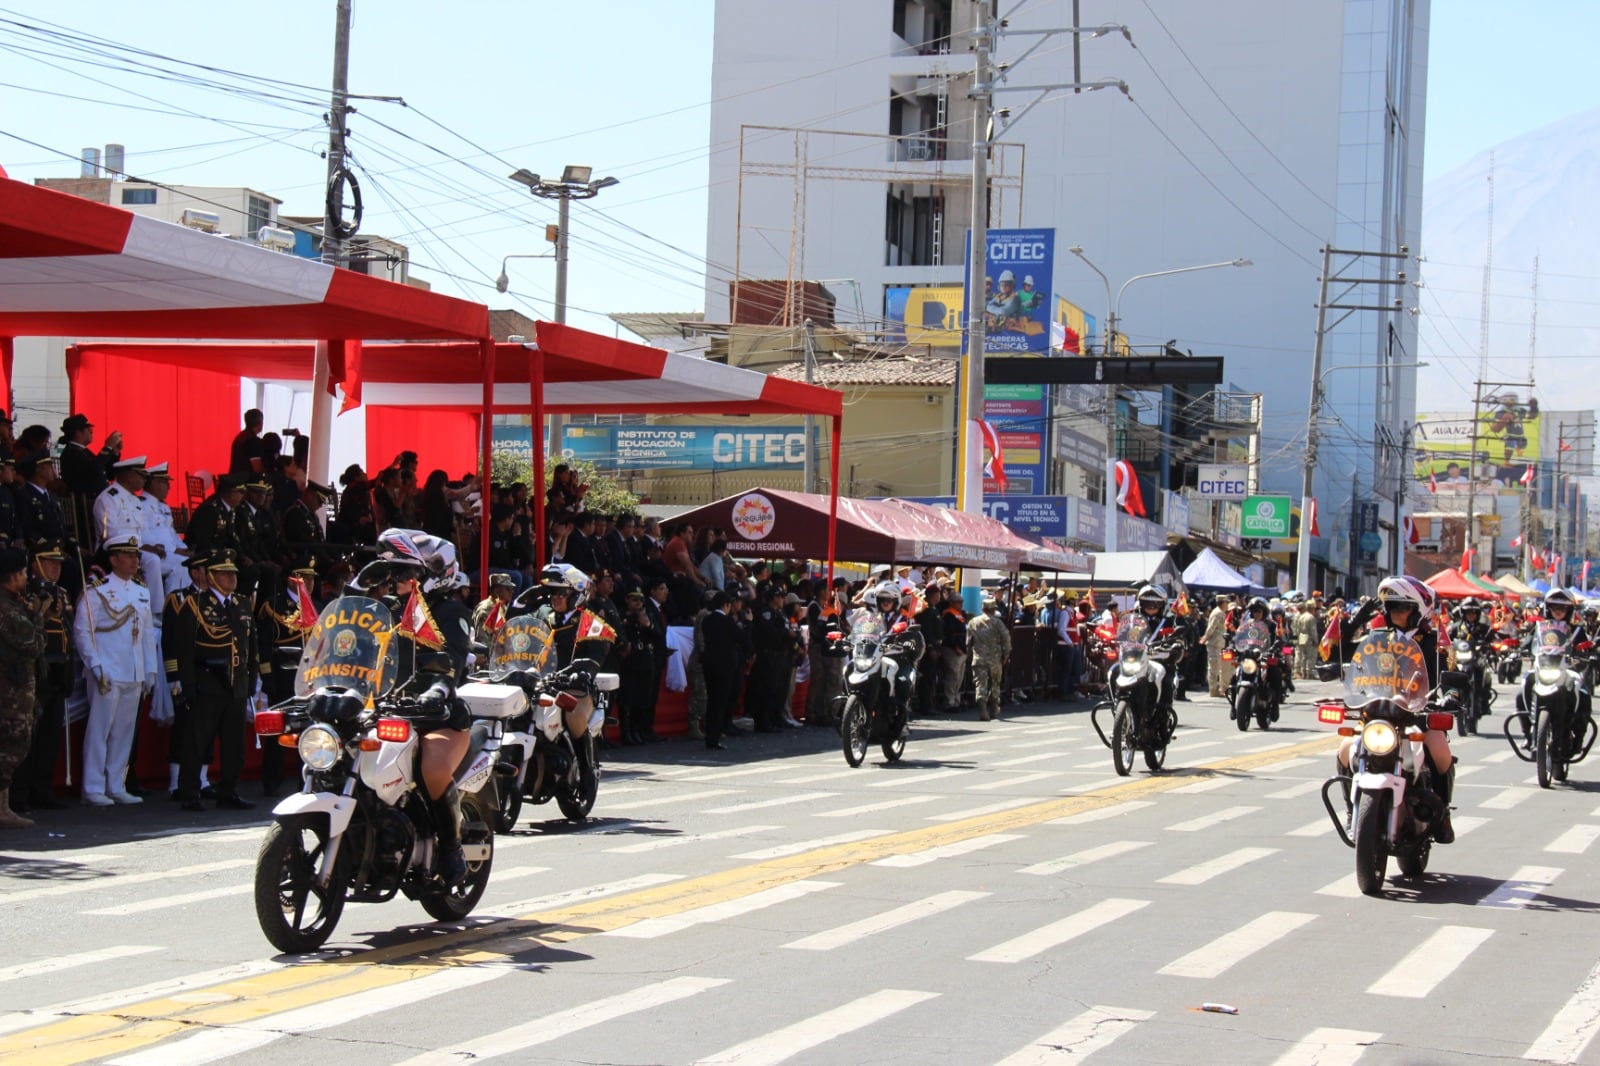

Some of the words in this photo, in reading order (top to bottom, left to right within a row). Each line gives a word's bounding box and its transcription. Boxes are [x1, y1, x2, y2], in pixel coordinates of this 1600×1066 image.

[990, 243, 1045, 260] CITEC
[617, 430, 677, 439] INSTITUTO
[680, 431, 696, 439] DE
[617, 439, 686, 448] EDUCACIÓN
[713, 432, 806, 463] CITEC
[1200, 480, 1245, 494] CITEC
[757, 542, 795, 551] REGIONAL
[1352, 641, 1422, 665] POLICIA
[303, 663, 377, 682] TRANSITO
[1353, 676, 1419, 692] TRANSITO
